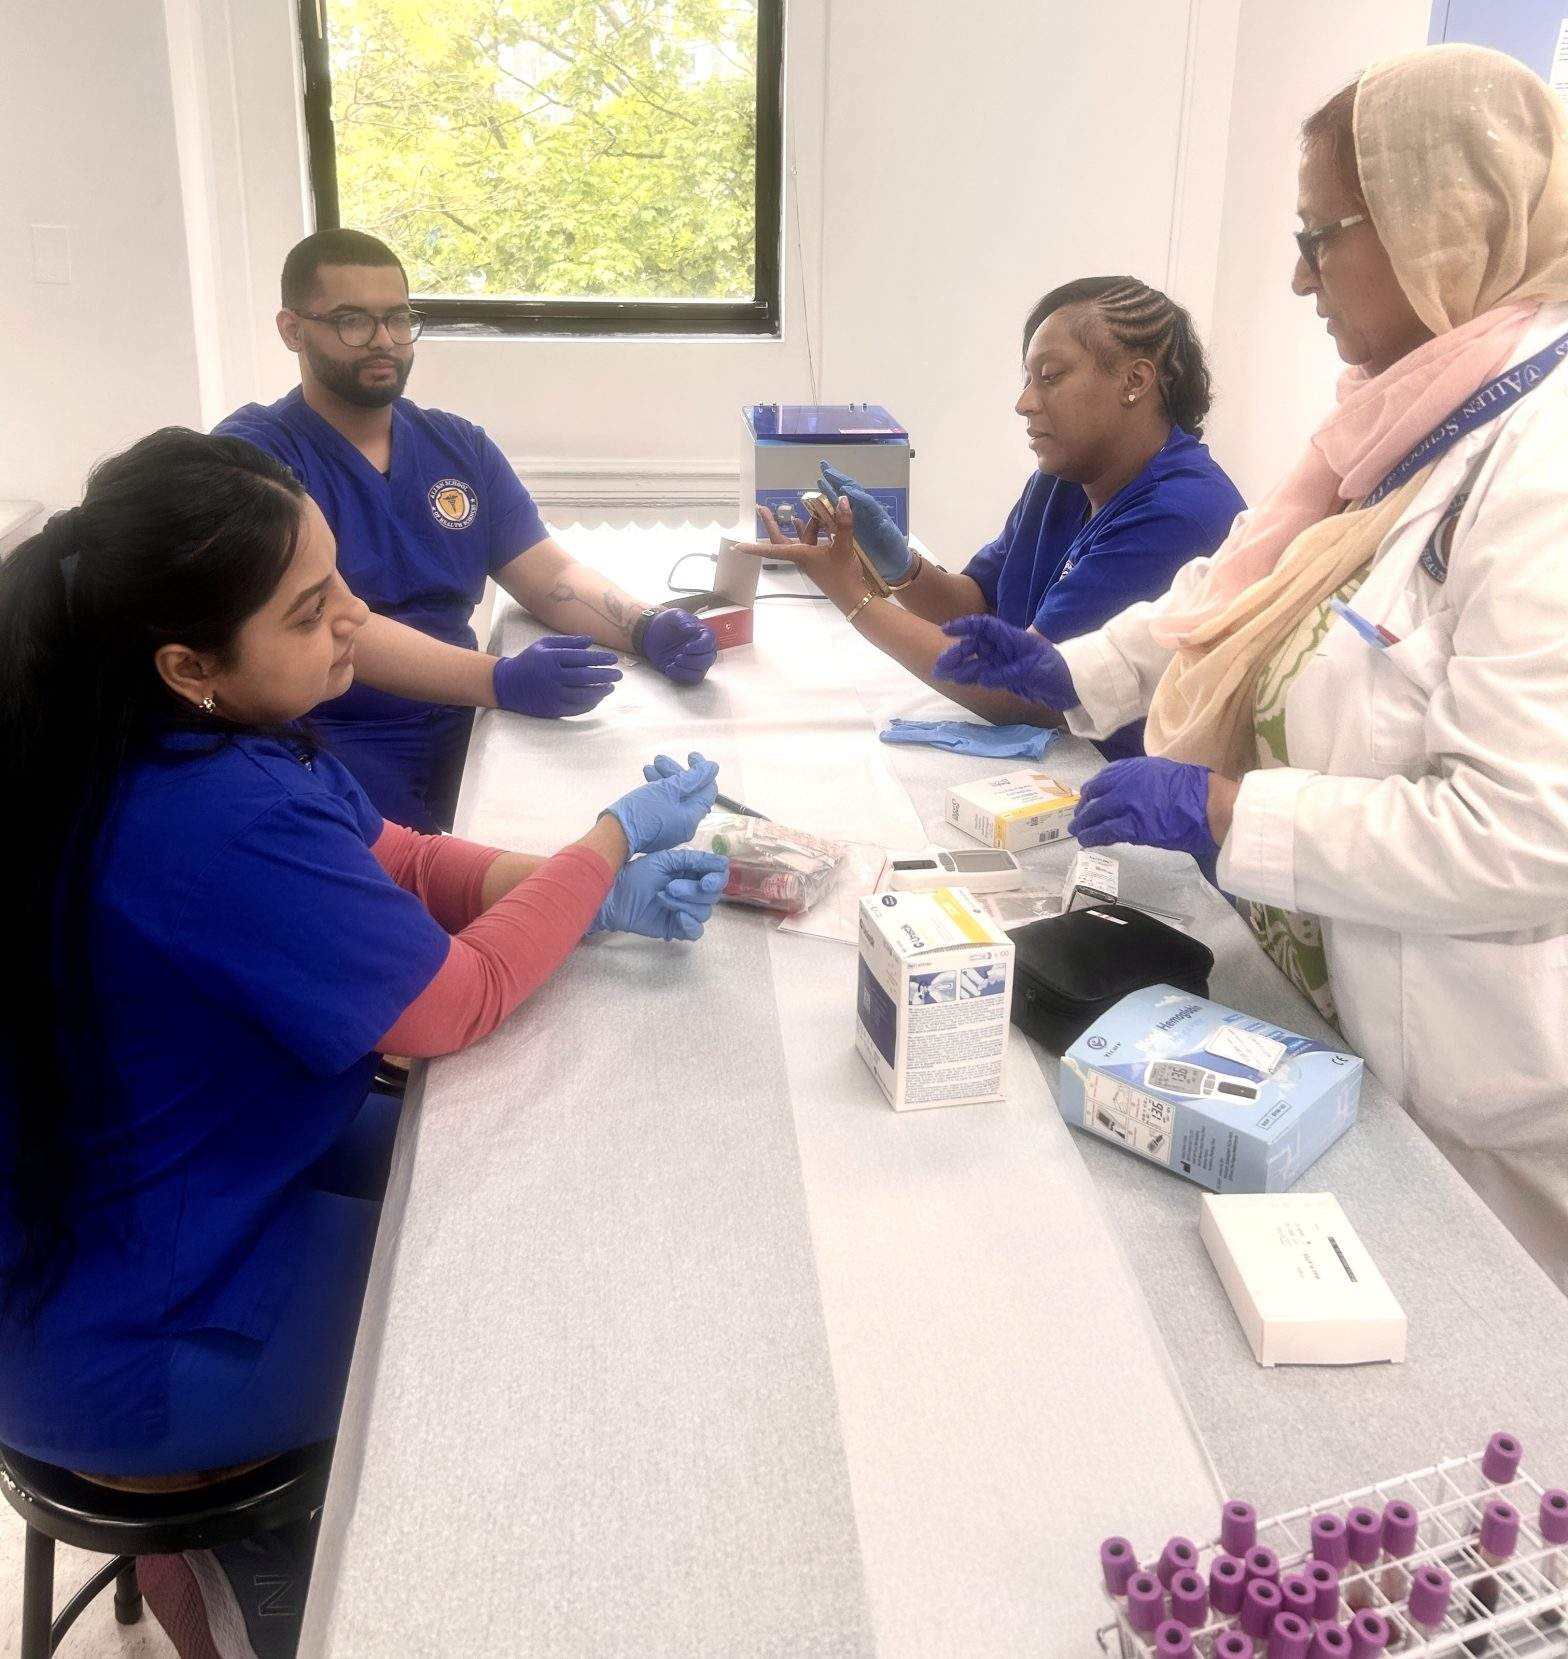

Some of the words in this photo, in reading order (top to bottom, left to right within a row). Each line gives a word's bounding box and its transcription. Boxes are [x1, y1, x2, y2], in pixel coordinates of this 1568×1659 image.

[1462, 372, 1523, 419] ALLEN
[1400, 418, 1460, 472] SCHOOL
[430, 481, 445, 499] ALLEN
[445, 480, 468, 492] SCHOOL
[1156, 1004, 1203, 1032] Hemoglobin
[1151, 1100, 1164, 1121] 136
